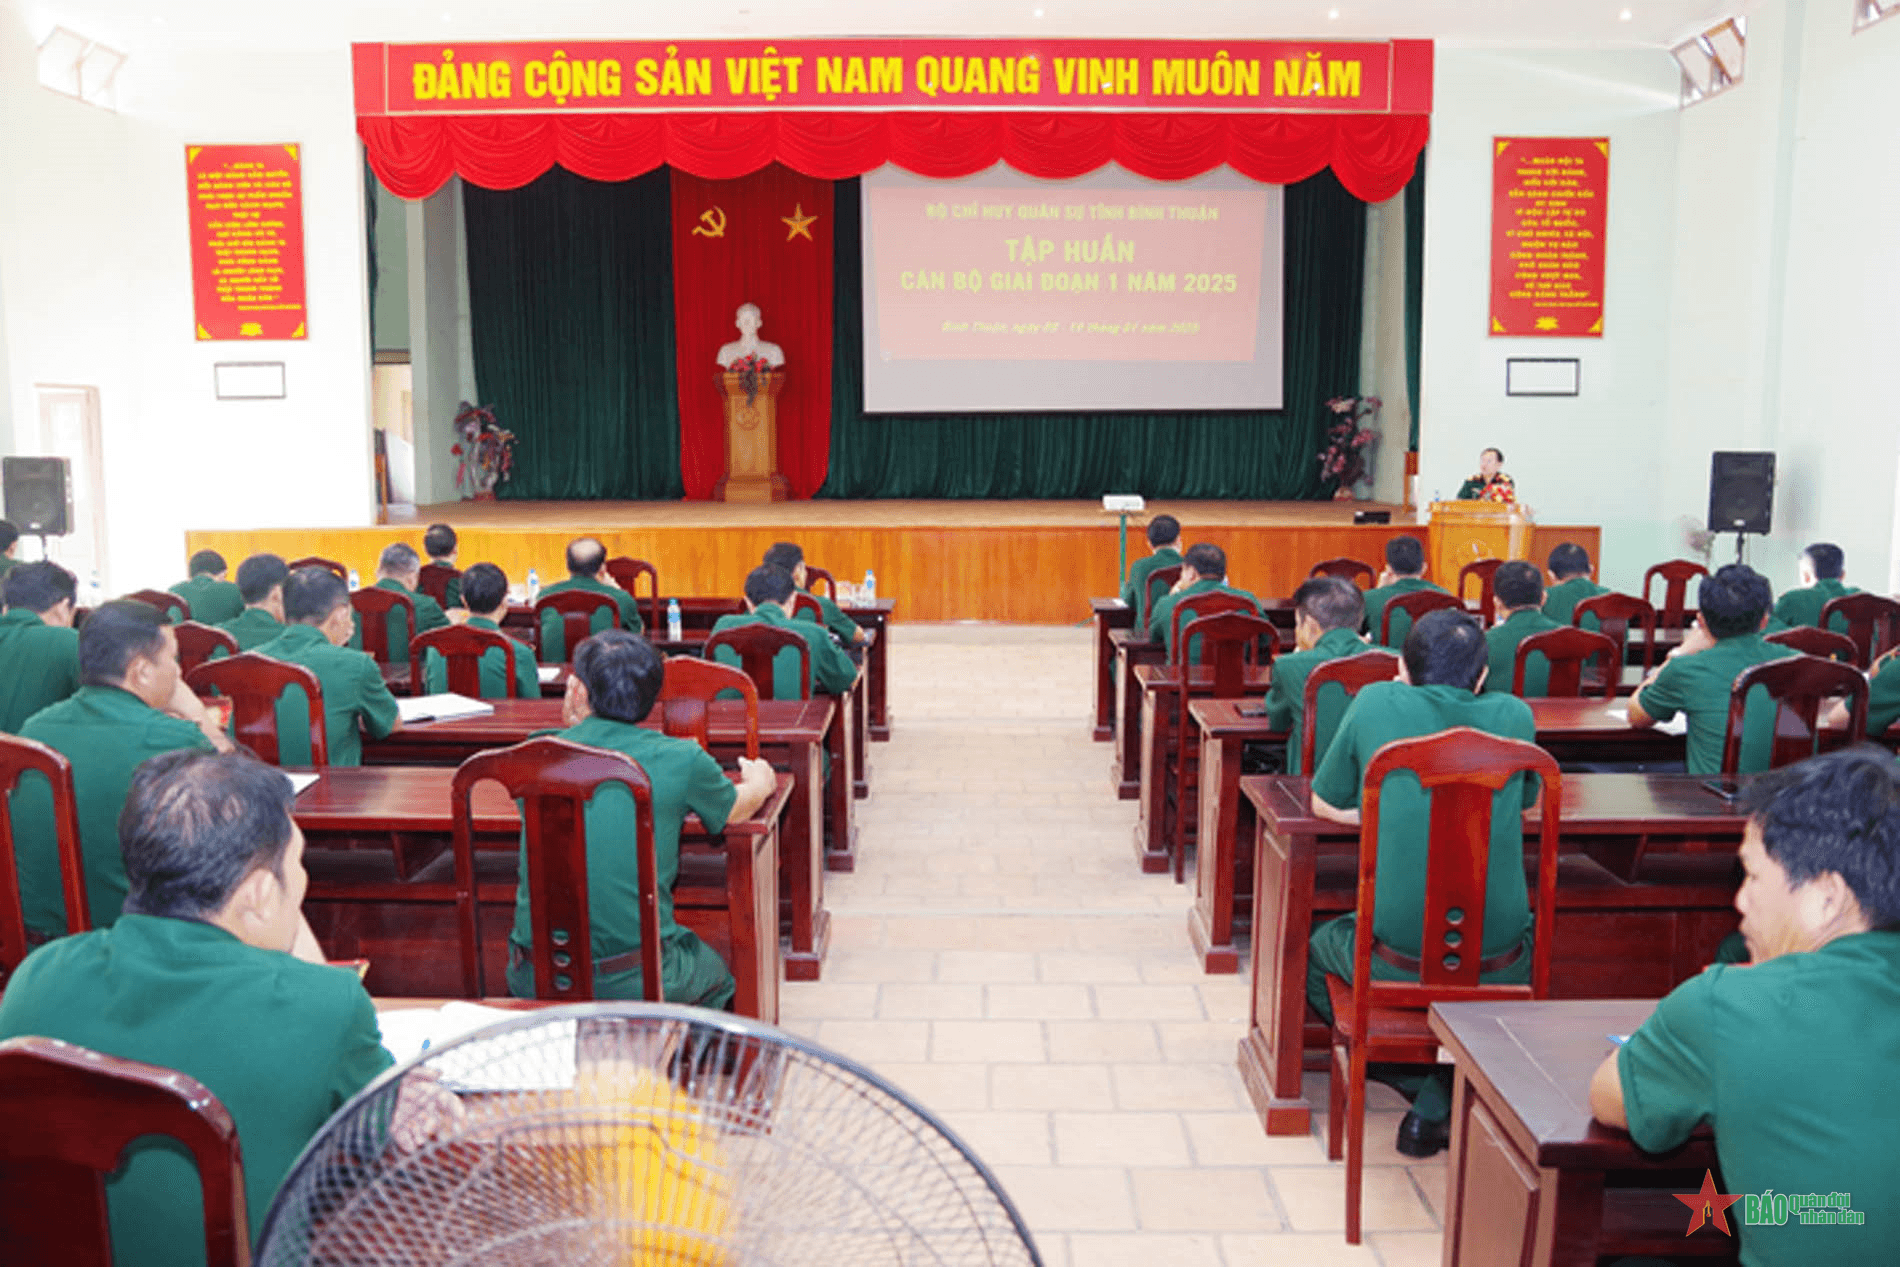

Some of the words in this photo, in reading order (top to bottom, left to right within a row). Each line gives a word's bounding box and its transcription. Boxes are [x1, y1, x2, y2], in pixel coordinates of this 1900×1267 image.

[413, 49, 511, 99] ĐẢNG
[524, 50, 621, 104] CỘNG
[635, 45, 711, 95] SẢN
[725, 46, 803, 101] VIỆT
[816, 56, 903, 94] NAM
[916, 55, 1040, 97] QUANG
[1053, 57, 1139, 95] VINH
[1152, 50, 1260, 96] MUÔN
[1273, 51, 1361, 97] NĂM
[1109, 272, 1118, 291] 1
[1183, 272, 1237, 293] 2025
